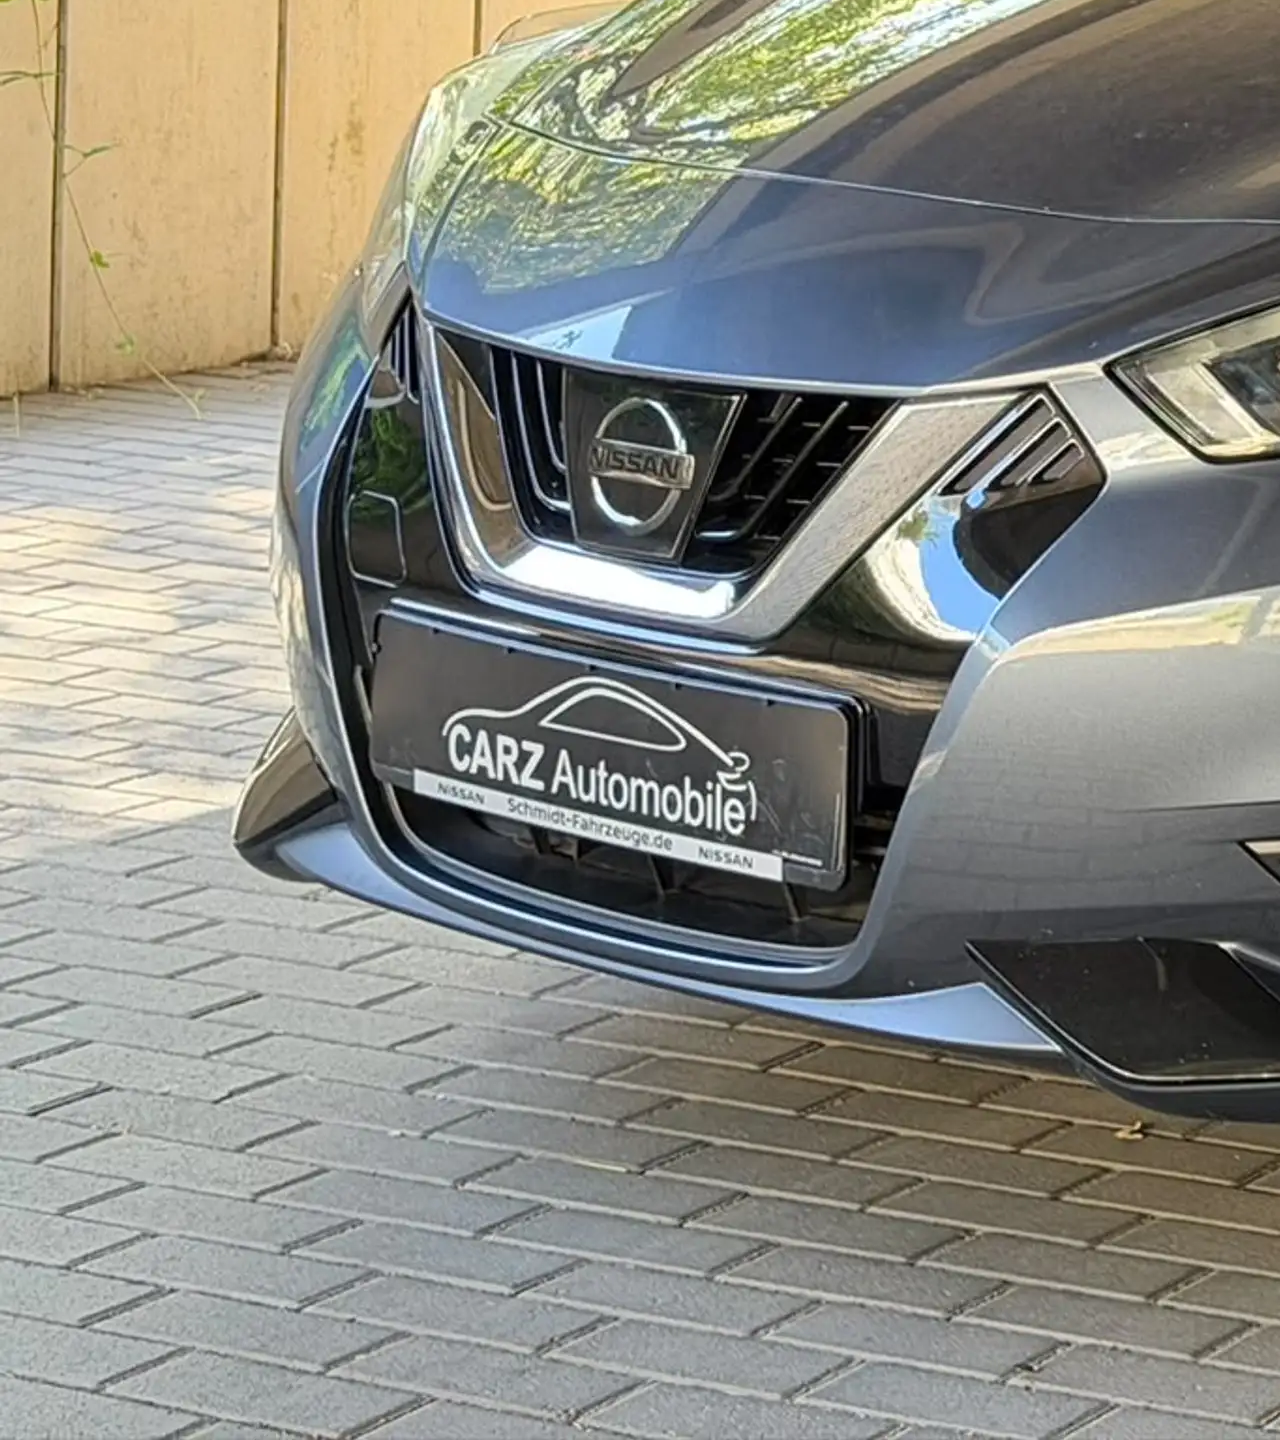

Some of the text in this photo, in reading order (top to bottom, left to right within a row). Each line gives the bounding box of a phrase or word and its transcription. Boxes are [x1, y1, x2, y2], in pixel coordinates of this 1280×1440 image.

[588, 445, 680, 481] NISSAN
[449, 723, 747, 836] CARZ Automobile
[437, 781, 486, 805] NISSAN
[507, 797, 674, 852] Schmidt-Fahrzeuge.de
[698, 845, 755, 869] NISSAN
